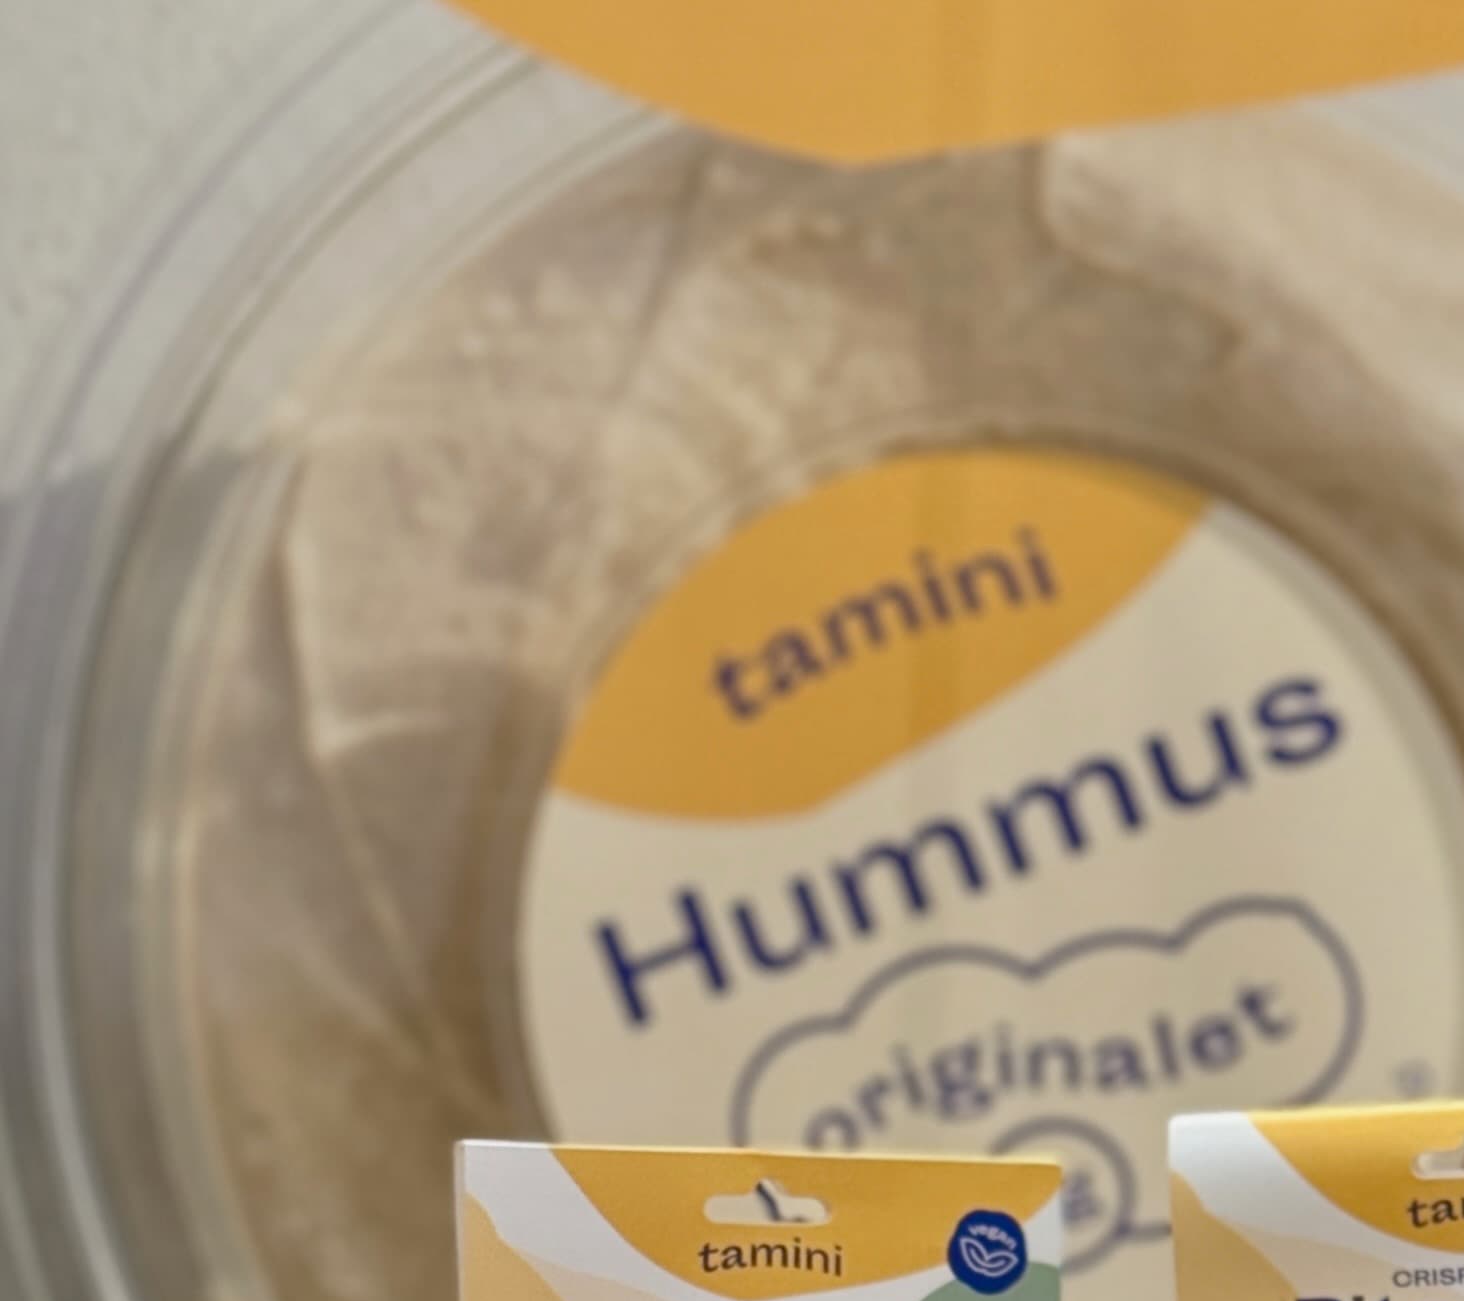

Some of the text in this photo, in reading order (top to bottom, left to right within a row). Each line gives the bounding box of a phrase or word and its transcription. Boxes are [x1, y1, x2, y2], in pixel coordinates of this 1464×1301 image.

[709, 525, 1063, 722] tamini
[592, 672, 1346, 1028] Hummus
[804, 978, 1298, 1153] originalet
[698, 1237, 845, 1277] tamini
